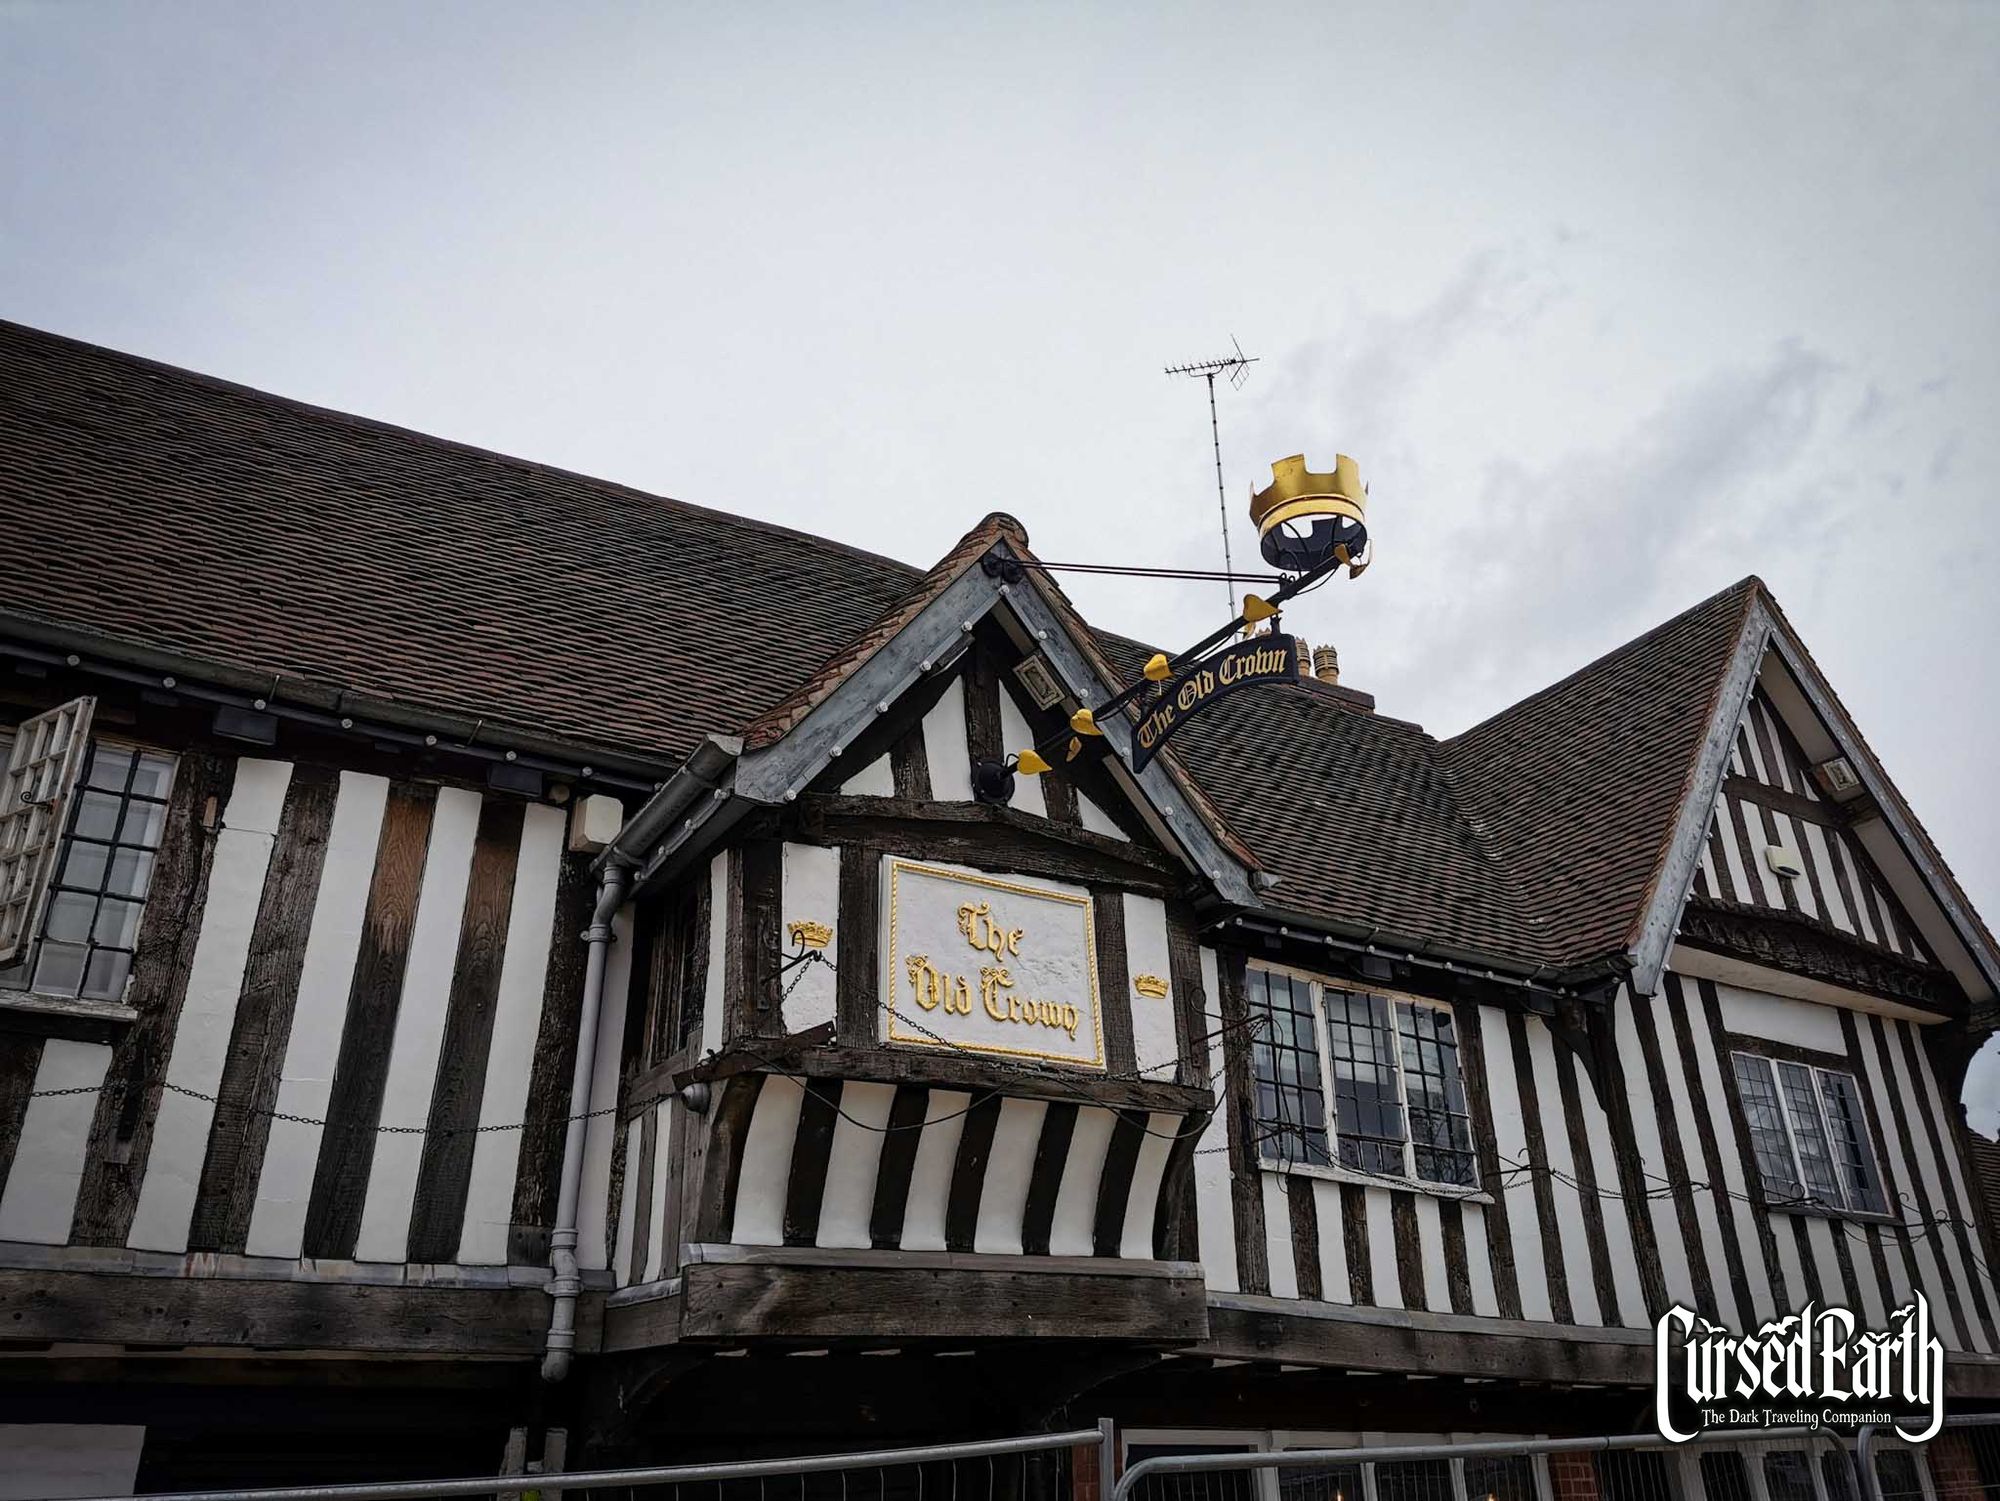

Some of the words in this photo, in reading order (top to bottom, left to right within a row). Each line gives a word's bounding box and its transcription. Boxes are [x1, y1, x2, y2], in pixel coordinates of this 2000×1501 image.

[1137, 703, 1176, 748] The
[1177, 669, 1215, 711] Old
[1218, 647, 1288, 685] Crown
[957, 900, 1024, 962] The
[905, 952, 973, 1016] Old
[979, 965, 1080, 1042] Crown
